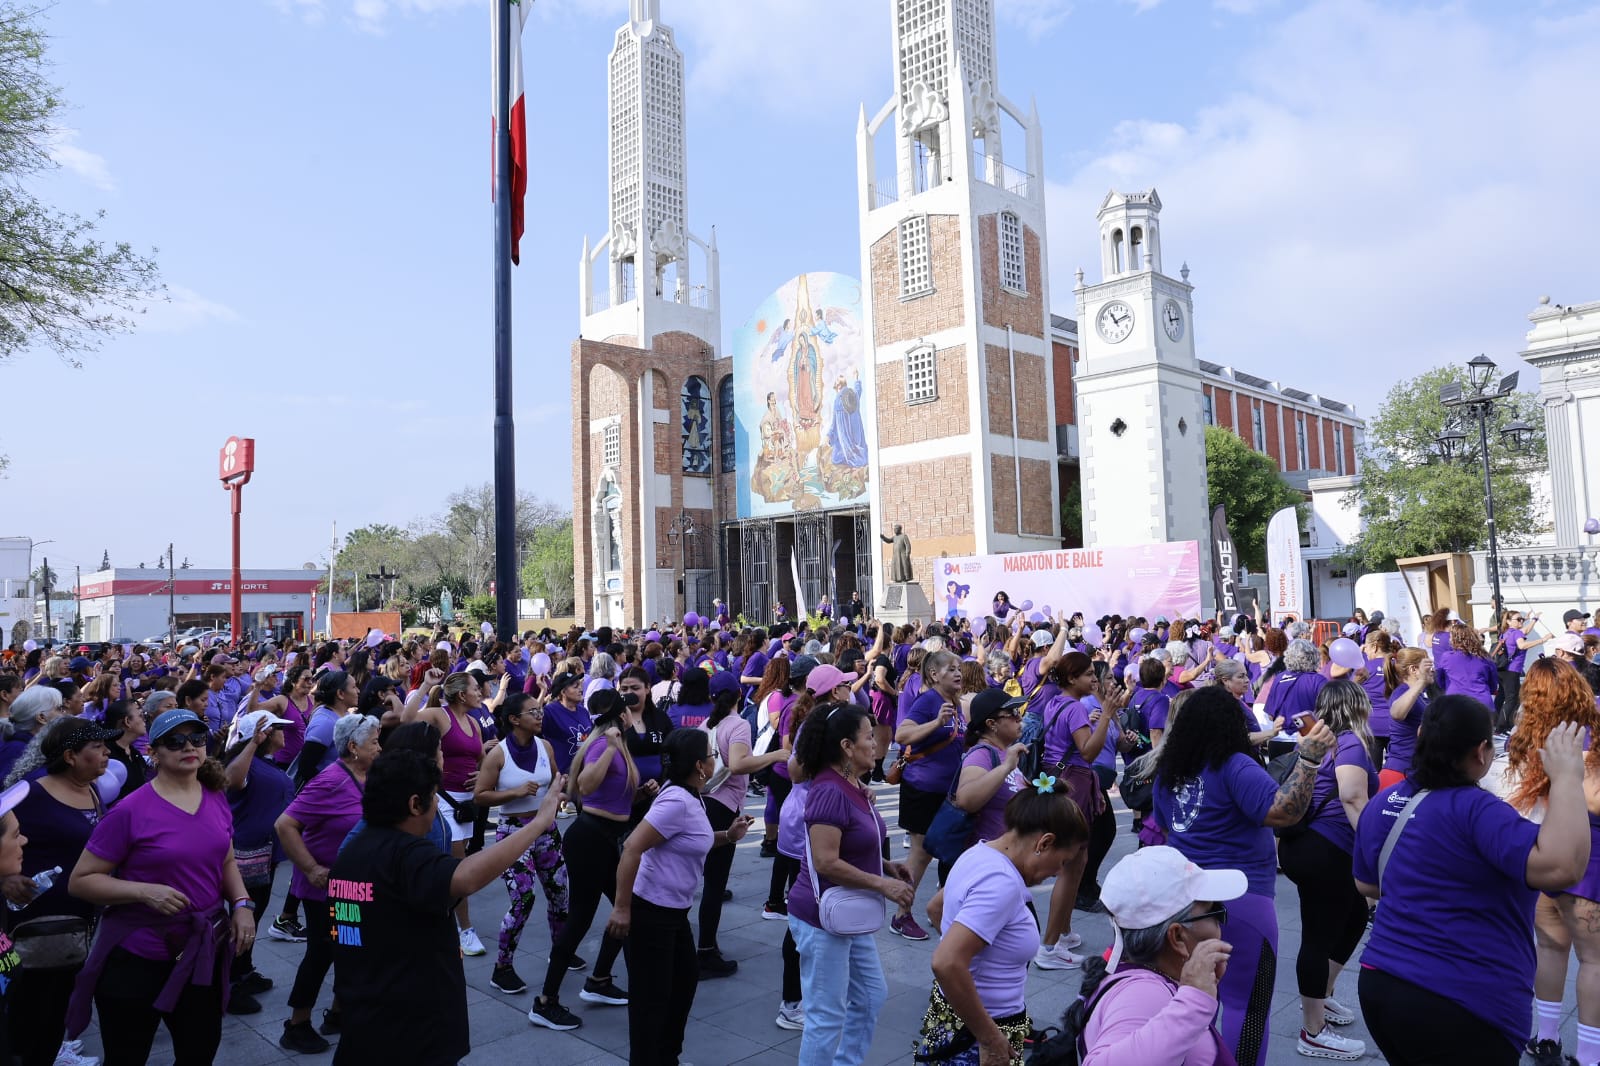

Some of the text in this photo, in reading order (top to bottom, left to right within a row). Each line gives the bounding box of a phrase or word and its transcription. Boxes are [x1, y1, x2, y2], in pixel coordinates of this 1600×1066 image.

[944, 562, 961, 575] 8M
[1003, 552, 1053, 573] MARATÓN
[1055, 552, 1070, 570] DE
[1072, 550, 1104, 569] BAILE
[1279, 573, 1287, 607] Deporte
